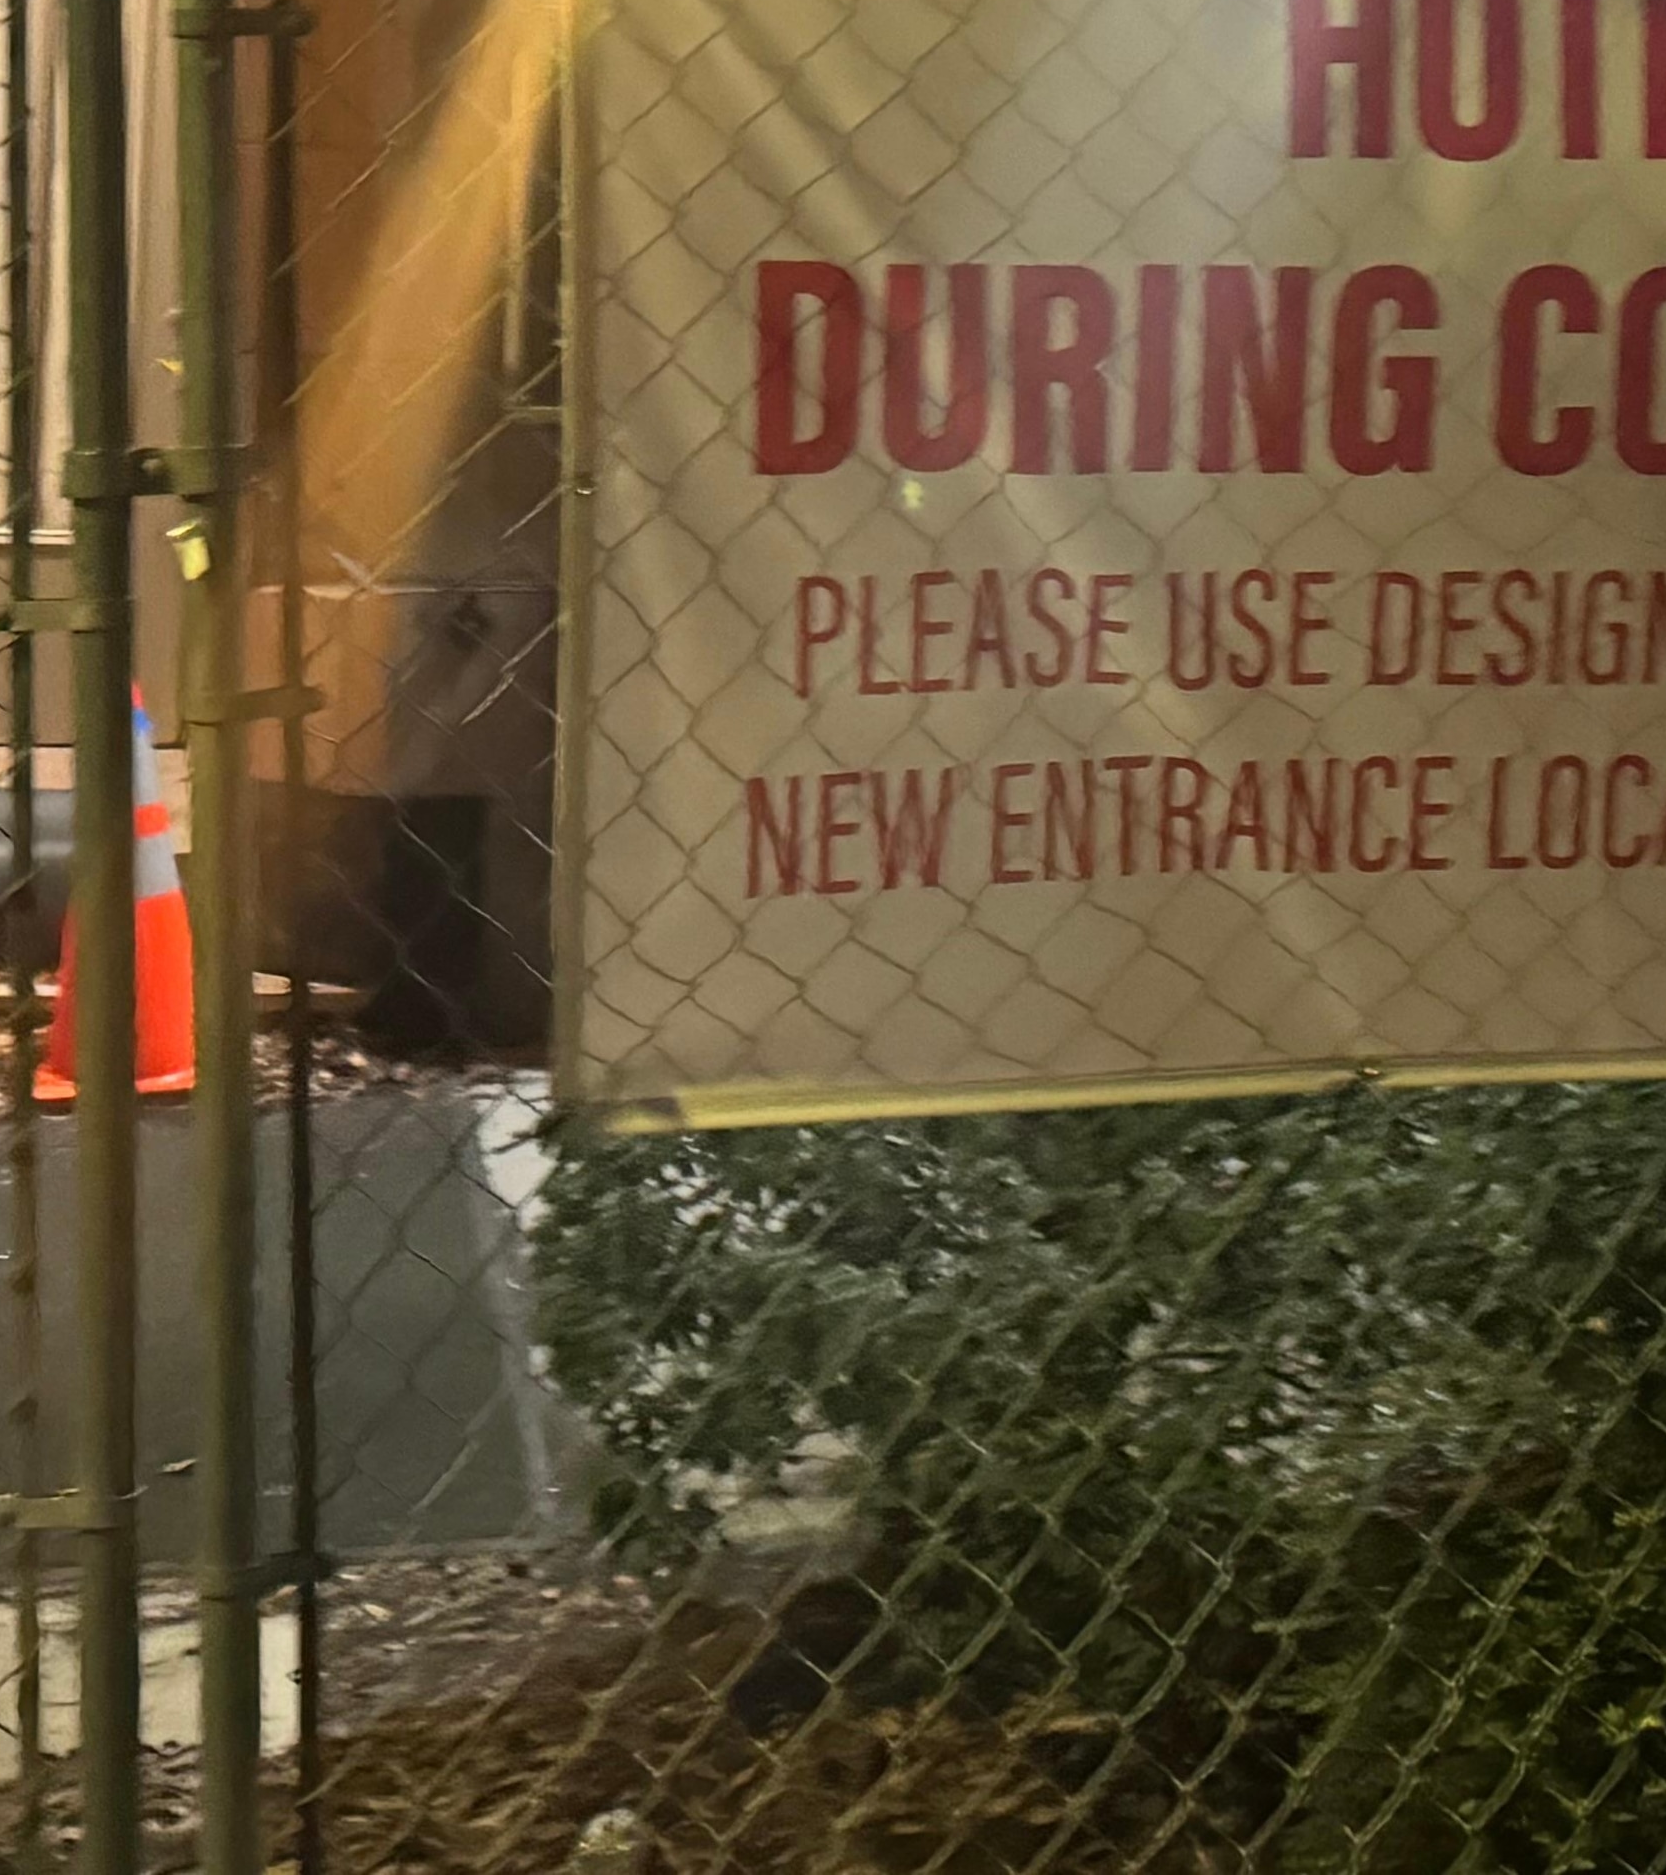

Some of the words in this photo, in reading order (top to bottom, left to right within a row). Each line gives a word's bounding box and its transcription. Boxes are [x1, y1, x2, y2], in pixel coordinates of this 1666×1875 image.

[752, 260, 1440, 477] DURING
[794, 568, 1133, 700] PLEASE
[1166, 568, 1335, 691] USE
[743, 761, 958, 900] NEW
[989, 754, 1457, 886] ENTRANCE
